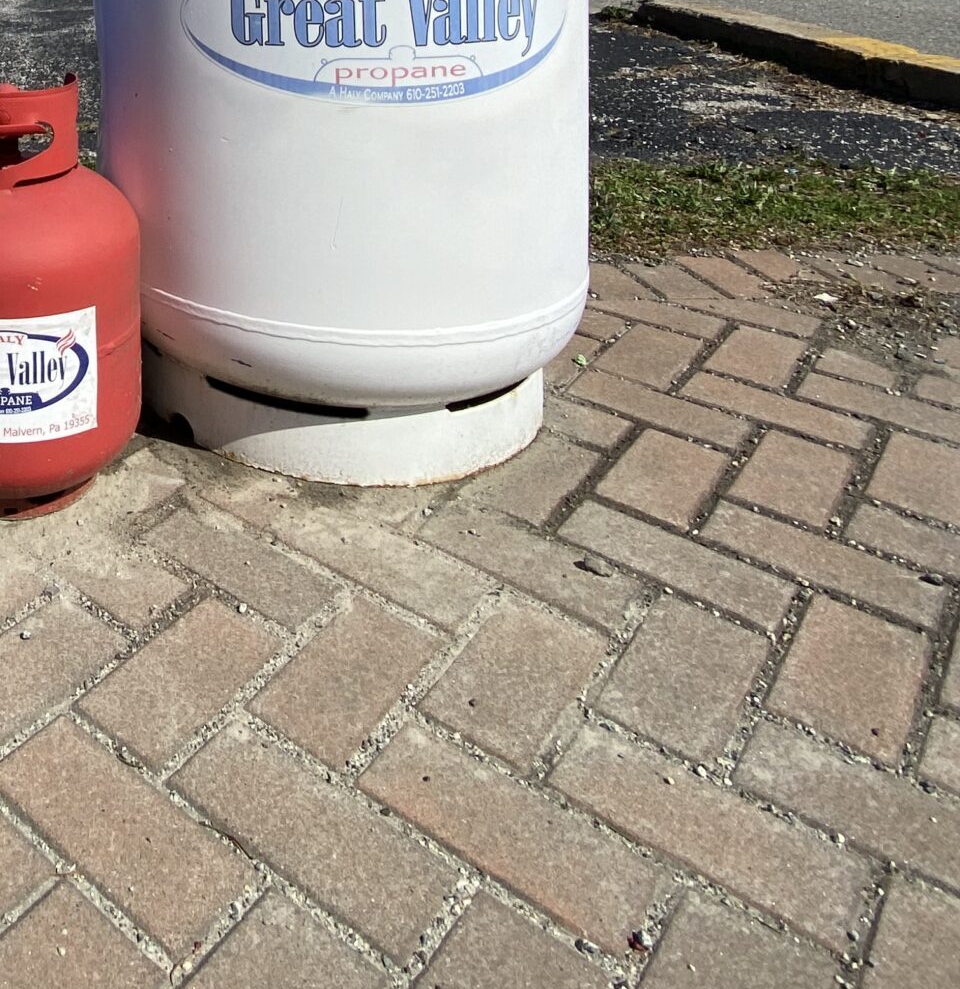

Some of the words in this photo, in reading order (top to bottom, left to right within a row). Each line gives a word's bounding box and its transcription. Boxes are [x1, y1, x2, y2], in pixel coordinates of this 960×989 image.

[335, 64, 467, 87] propane
[328, 85, 337, 98] A
[406, 83, 466, 100] 610-251-2203
[7, 350, 68, 389] Valley
[3, 425, 46, 437] Malvern,
[49, 423, 61, 433] Pa
[64, 416, 90, 431] 19355
